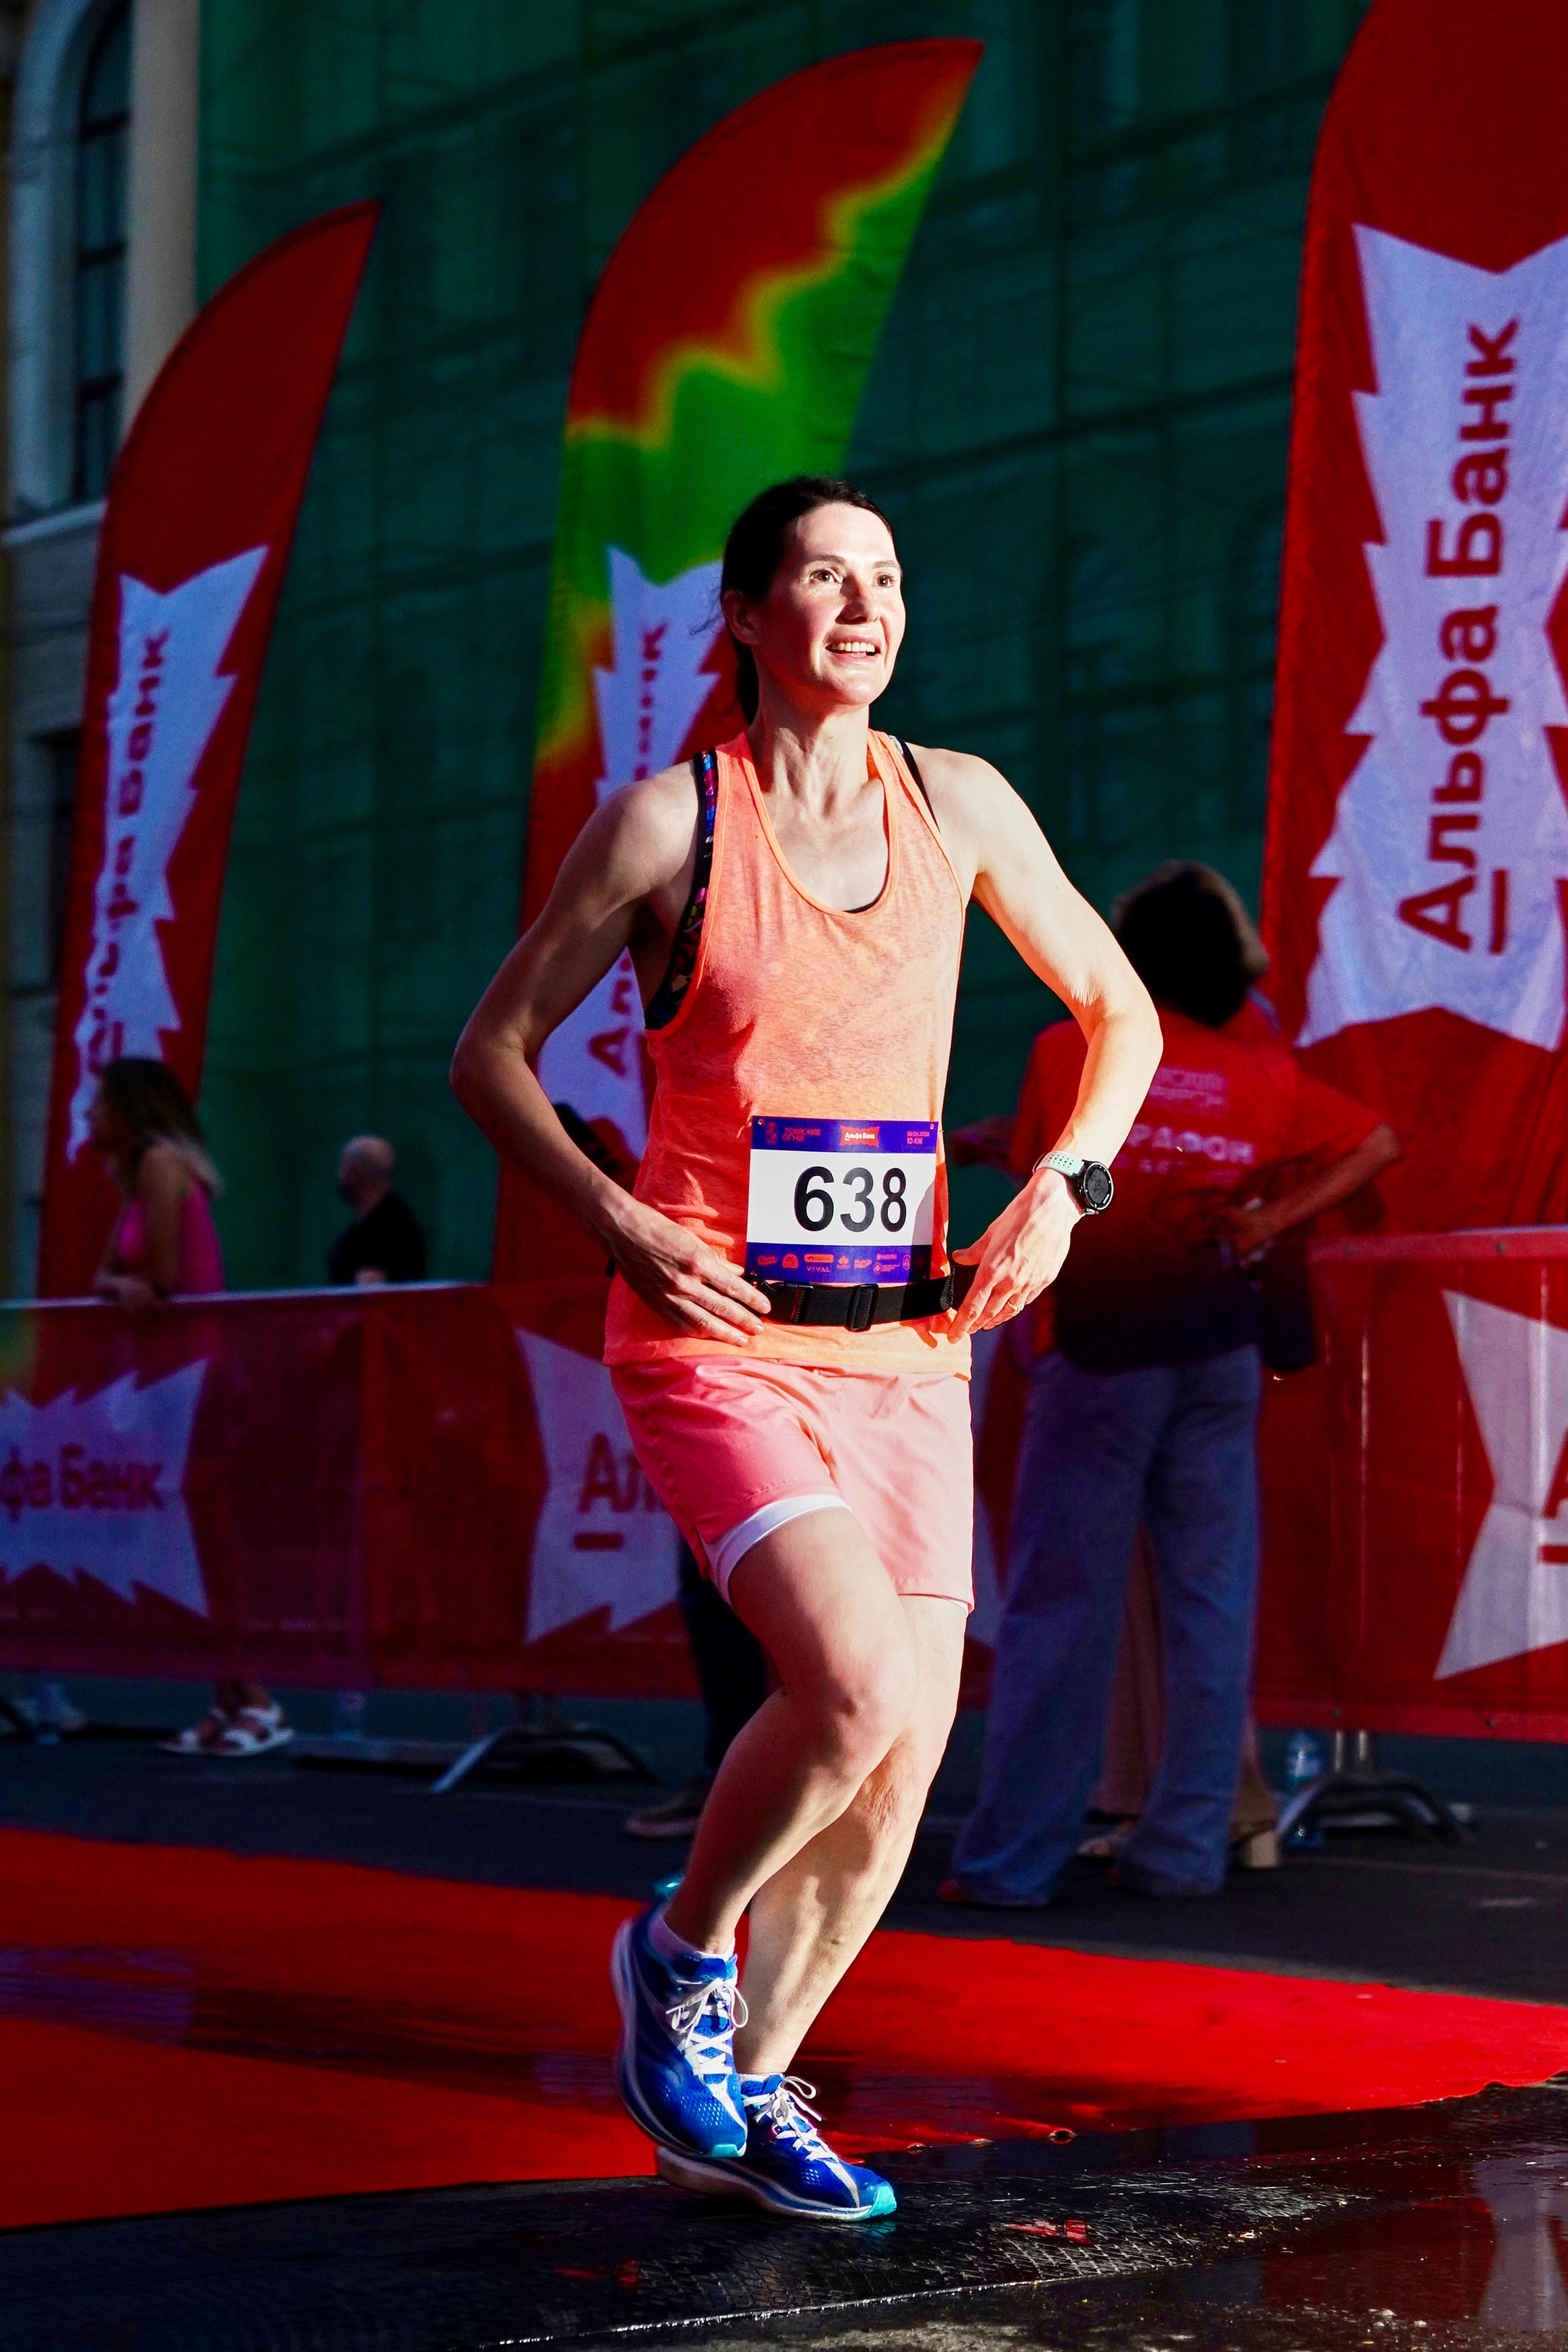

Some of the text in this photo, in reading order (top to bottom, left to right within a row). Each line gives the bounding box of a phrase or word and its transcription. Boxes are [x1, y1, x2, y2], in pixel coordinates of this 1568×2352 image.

[1396, 316, 1519, 954] Альфа Банк
[845, 1132, 862, 1140] Альфа
[794, 1166, 907, 1232] 638
[61, 1442, 164, 1511] Банк
